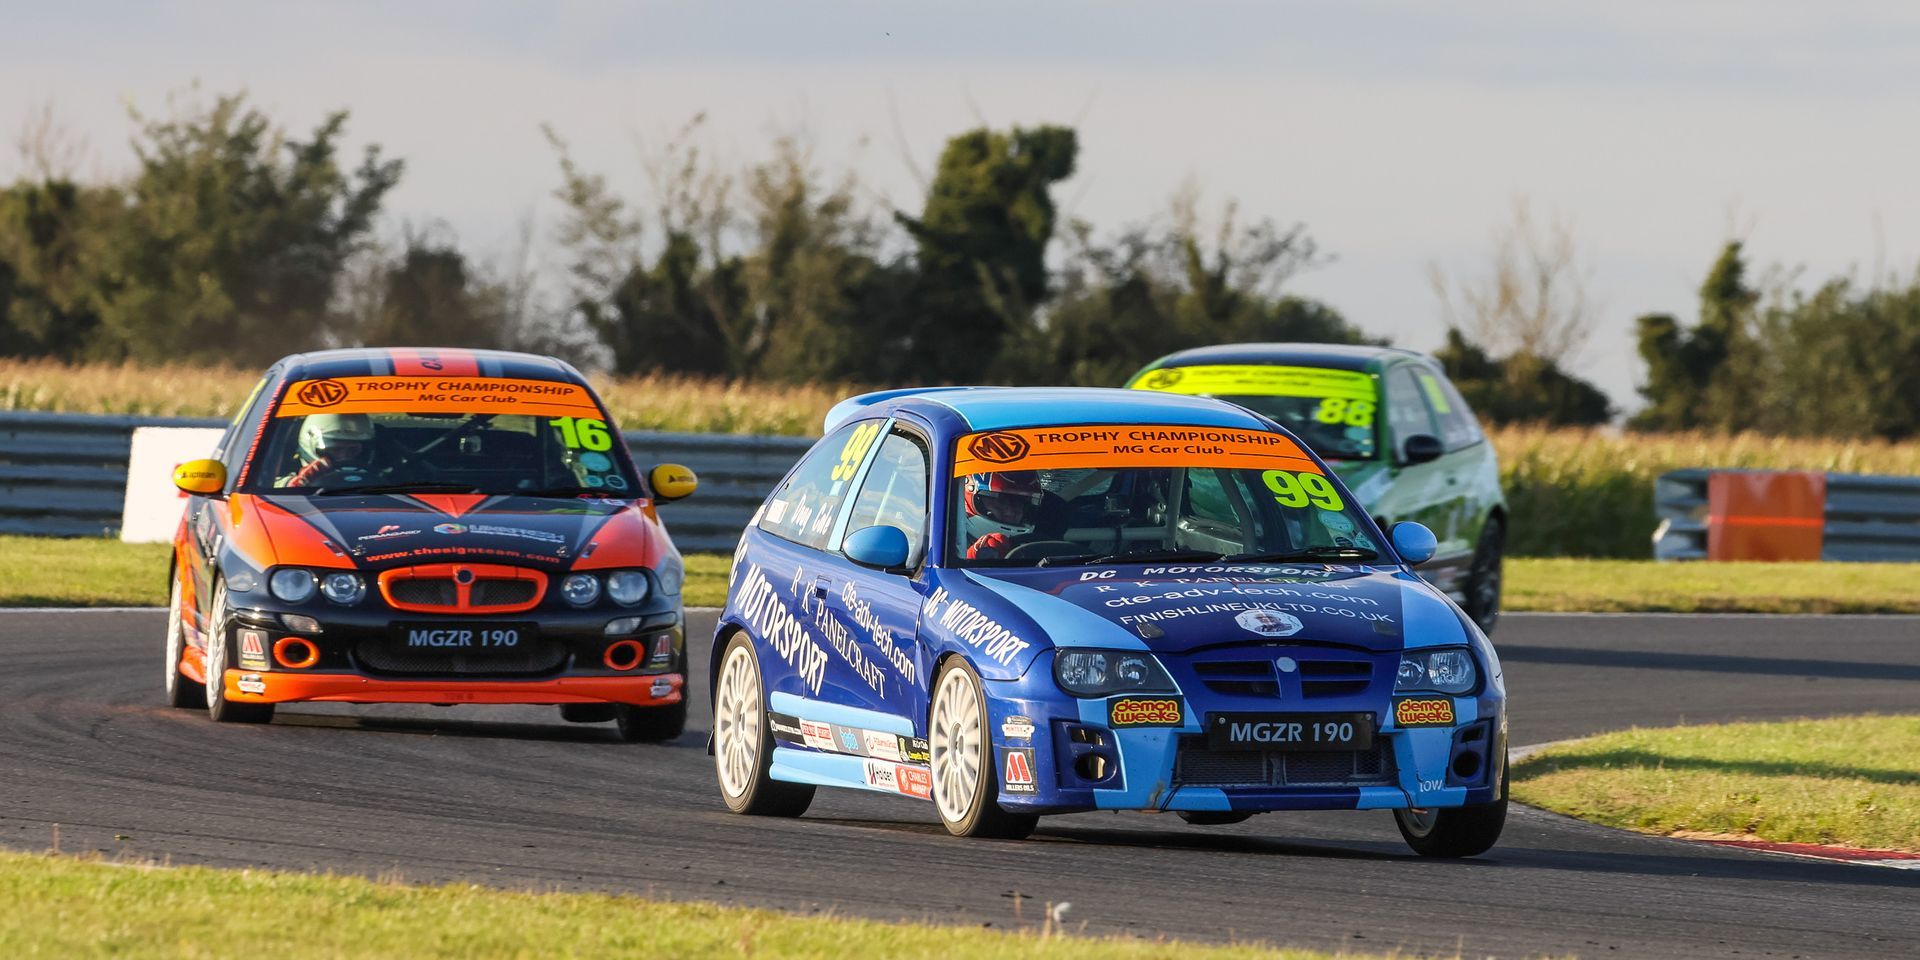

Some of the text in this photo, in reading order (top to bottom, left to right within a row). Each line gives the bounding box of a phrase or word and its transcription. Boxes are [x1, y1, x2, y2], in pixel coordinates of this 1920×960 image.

[301, 381, 346, 406] MG
[355, 381, 575, 397] TROPHY CHAMPIONSHIP
[418, 393, 518, 403] MG Car Club
[1316, 397, 1376, 426] 88
[549, 416, 612, 451] 16
[1034, 431, 1281, 447] TROPHY CHAMPIONSHIP
[831, 423, 879, 481] 99
[972, 434, 1026, 462] MG
[1112, 444, 1225, 455] MG Car Club
[1262, 470, 1345, 511] 99
[366, 547, 561, 564] www.thesignteam.com
[1079, 565, 1337, 582] DC MOTORSPORT
[1094, 576, 1352, 593] R K PANELCRAFT
[1105, 586, 1380, 608] cte-adv-tech.com
[1119, 602, 1396, 625] FINISHLINEUKLTD.CO.UK
[735, 563, 828, 697] MOTORSPORT
[790, 565, 886, 700] R K PANELCRAFT
[841, 580, 916, 686] cte-adv-tech.com
[923, 586, 1031, 667] DC MOTORSPORT
[408, 630, 518, 647] MGZR 190
[1114, 698, 1178, 712] demon
[1399, 698, 1450, 712] demon
[1111, 710, 1181, 725] tweeks
[1397, 710, 1453, 724] tweeks
[1230, 722, 1353, 742] MGZR 190
